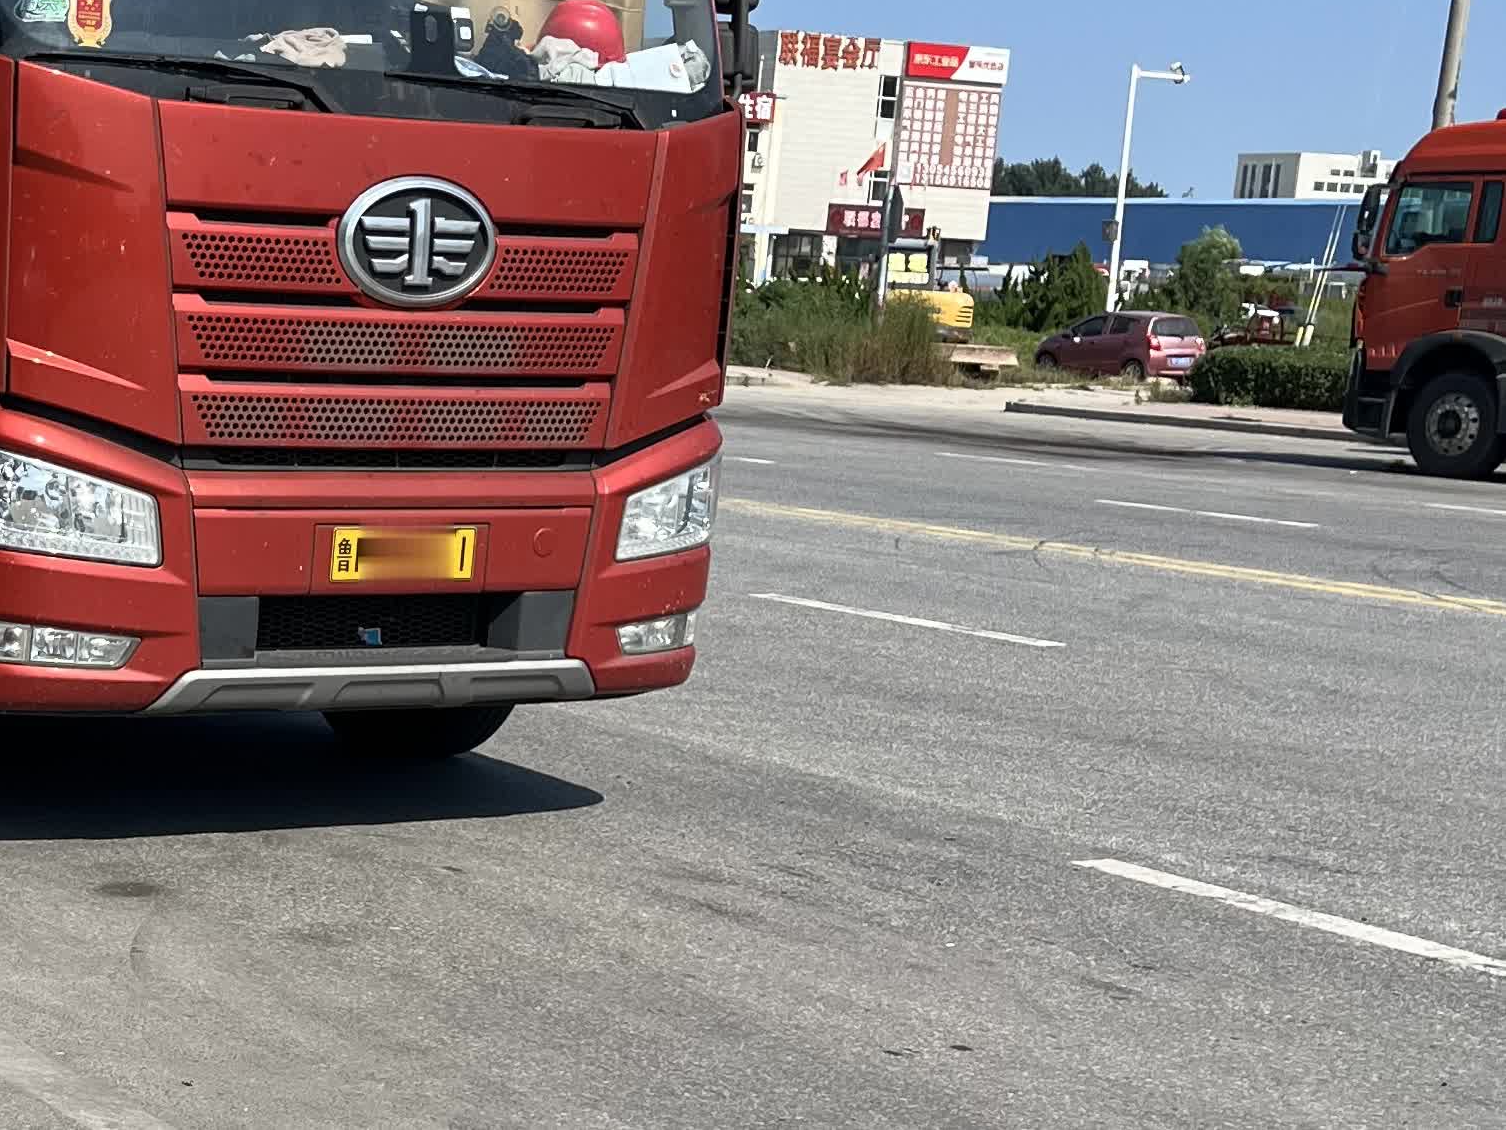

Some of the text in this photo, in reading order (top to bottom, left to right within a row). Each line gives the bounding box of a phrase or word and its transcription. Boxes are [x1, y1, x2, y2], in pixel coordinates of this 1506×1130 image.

[780, 31, 882, 70] 联福宴会厅
